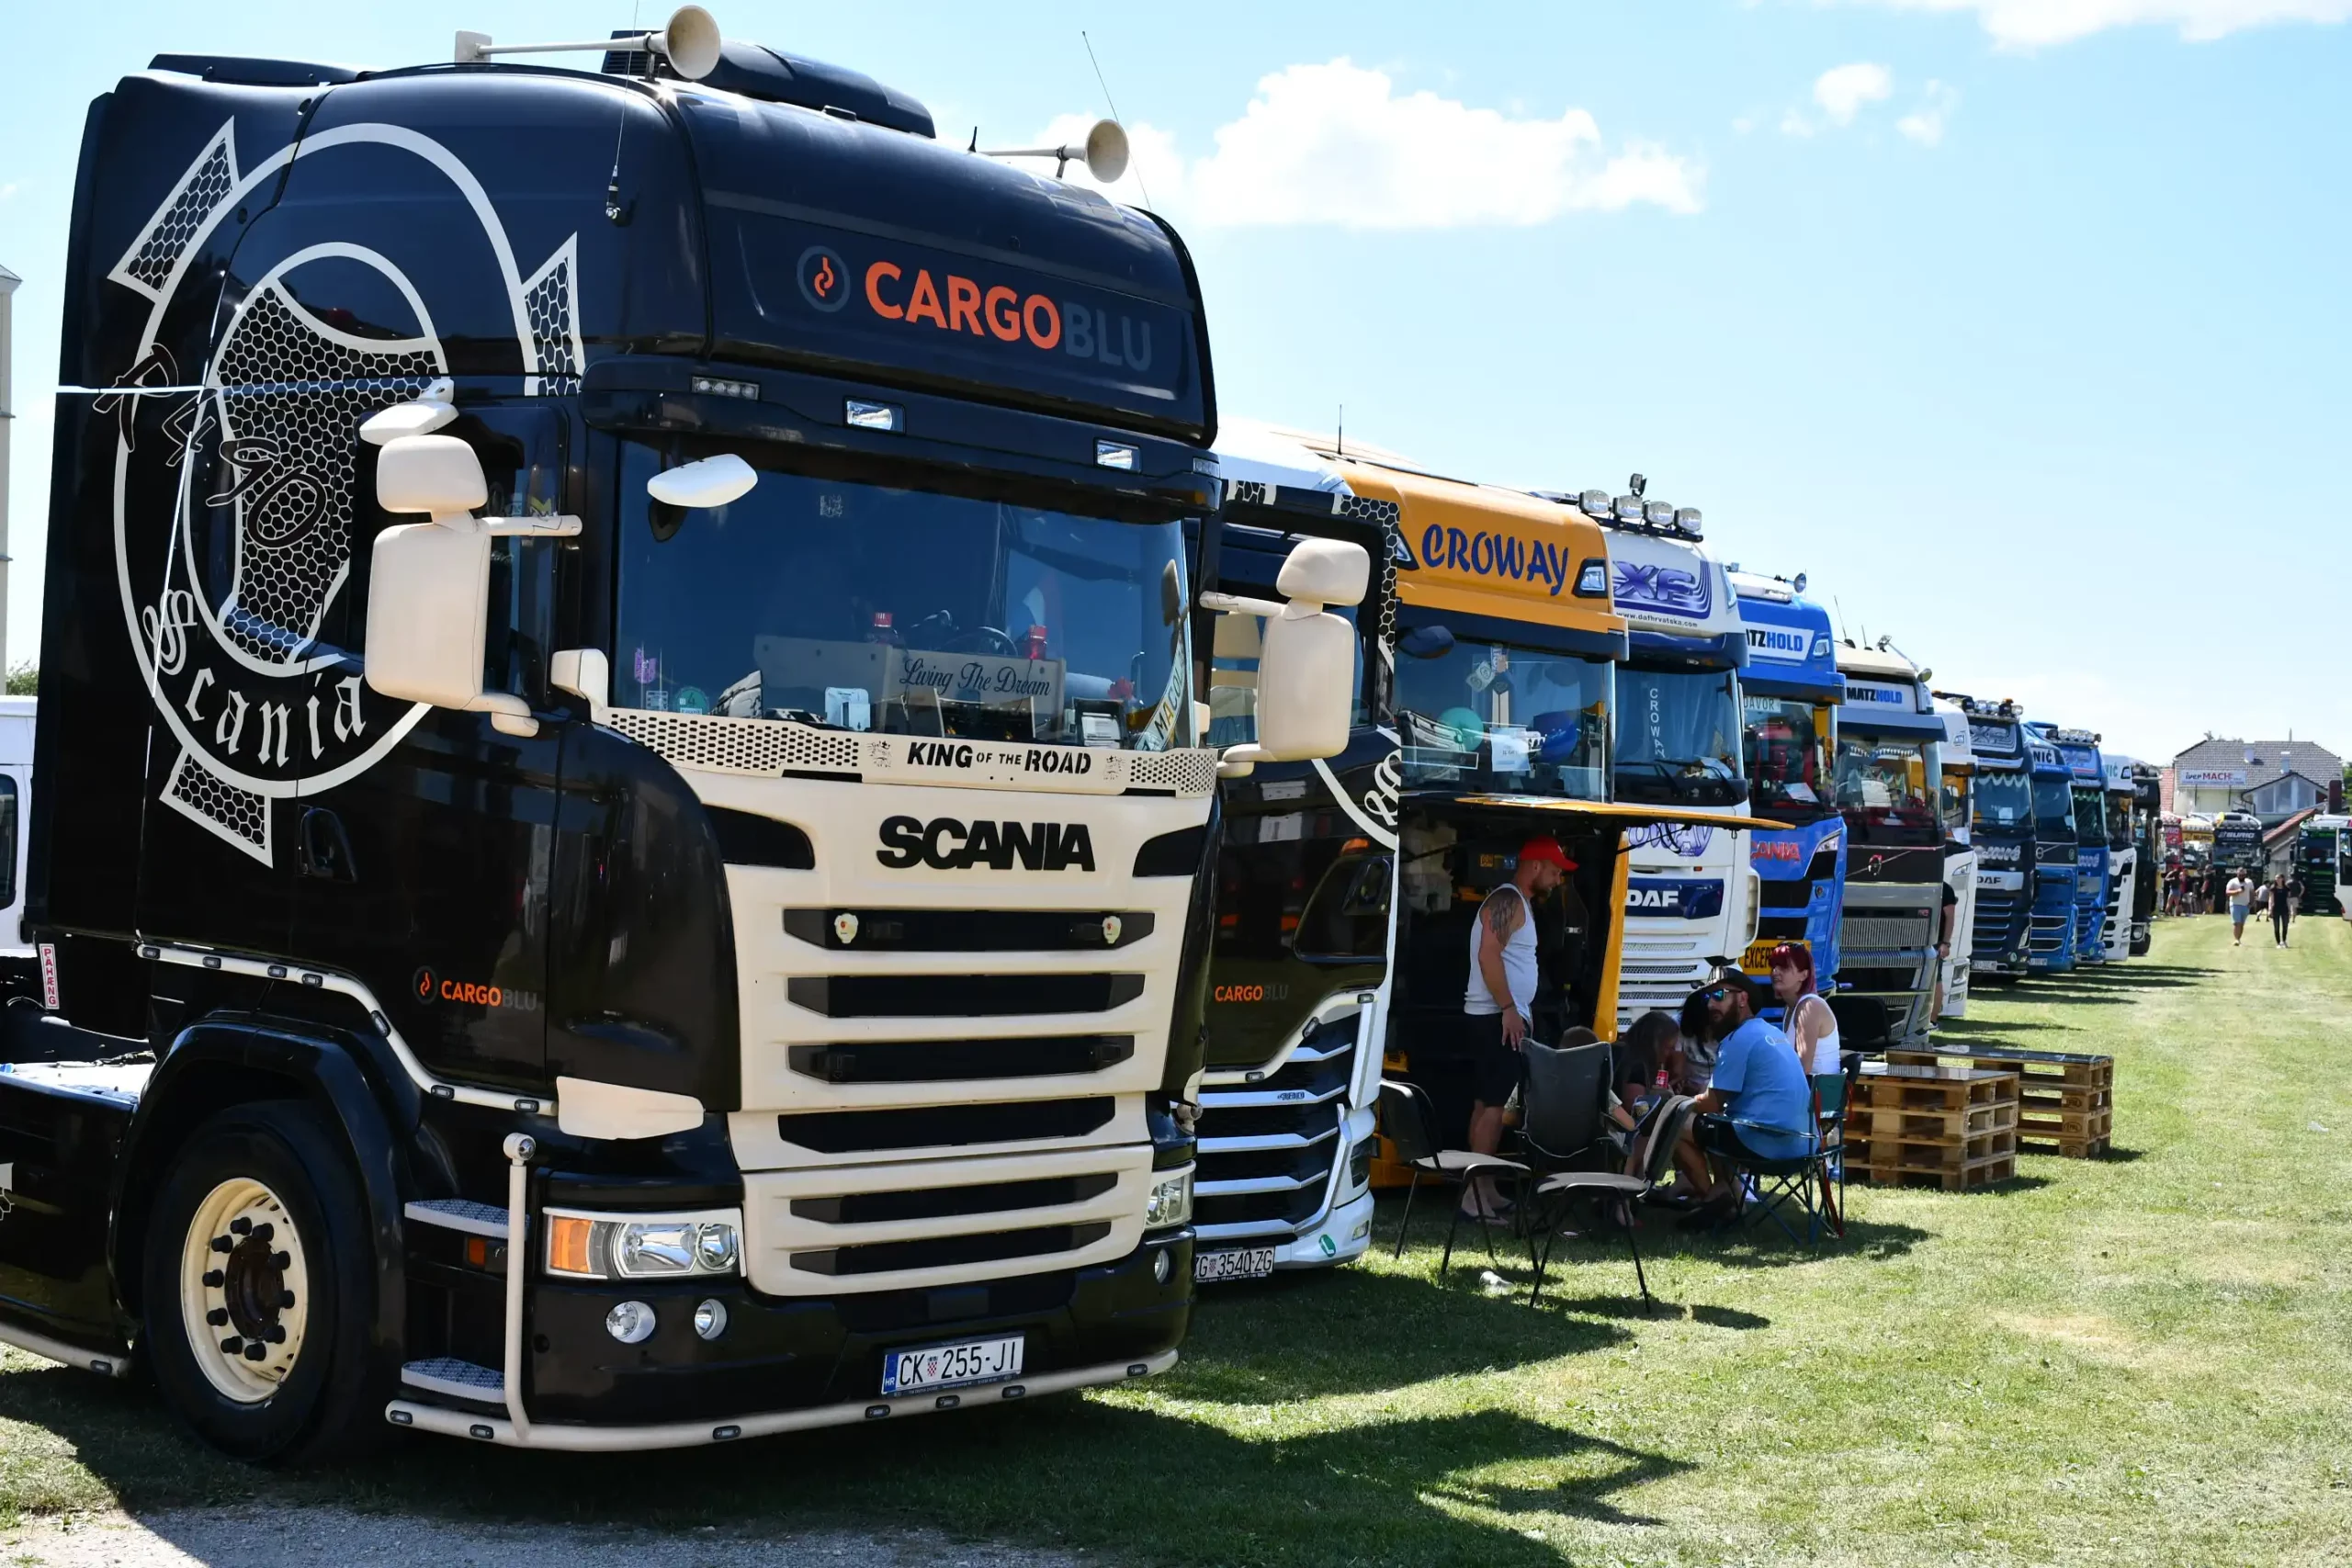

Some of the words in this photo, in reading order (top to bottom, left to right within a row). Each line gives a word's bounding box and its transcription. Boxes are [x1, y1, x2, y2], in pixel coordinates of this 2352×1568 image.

[865, 261, 1152, 372] CARGOBLU
[1422, 524, 1568, 596] CROWAY
[1612, 560, 1696, 601] XF
[1616, 611, 1698, 627] www.dafhrvatska.com
[899, 658, 954, 695] Living
[958, 662, 991, 691] The
[995, 666, 1051, 696] Dream
[1743, 696, 1775, 710] DAVOR
[1847, 687, 1903, 705] MATZHOLD
[1650, 688, 1666, 759] CROWAY
[908, 741, 973, 768] KING
[977, 752, 992, 763] OF
[1000, 753, 1022, 764] THE
[1024, 749, 1091, 774] ROAD
[876, 816, 1096, 872] SCANIA
[1977, 875, 2002, 885] DAF
[1625, 888, 1679, 908] DAF
[1744, 946, 1777, 969] EXCEP
[441, 980, 538, 1010] CARGOBLU
[1215, 985, 1288, 1002] CARGOBLU
[885, 1377, 896, 1386] HR
